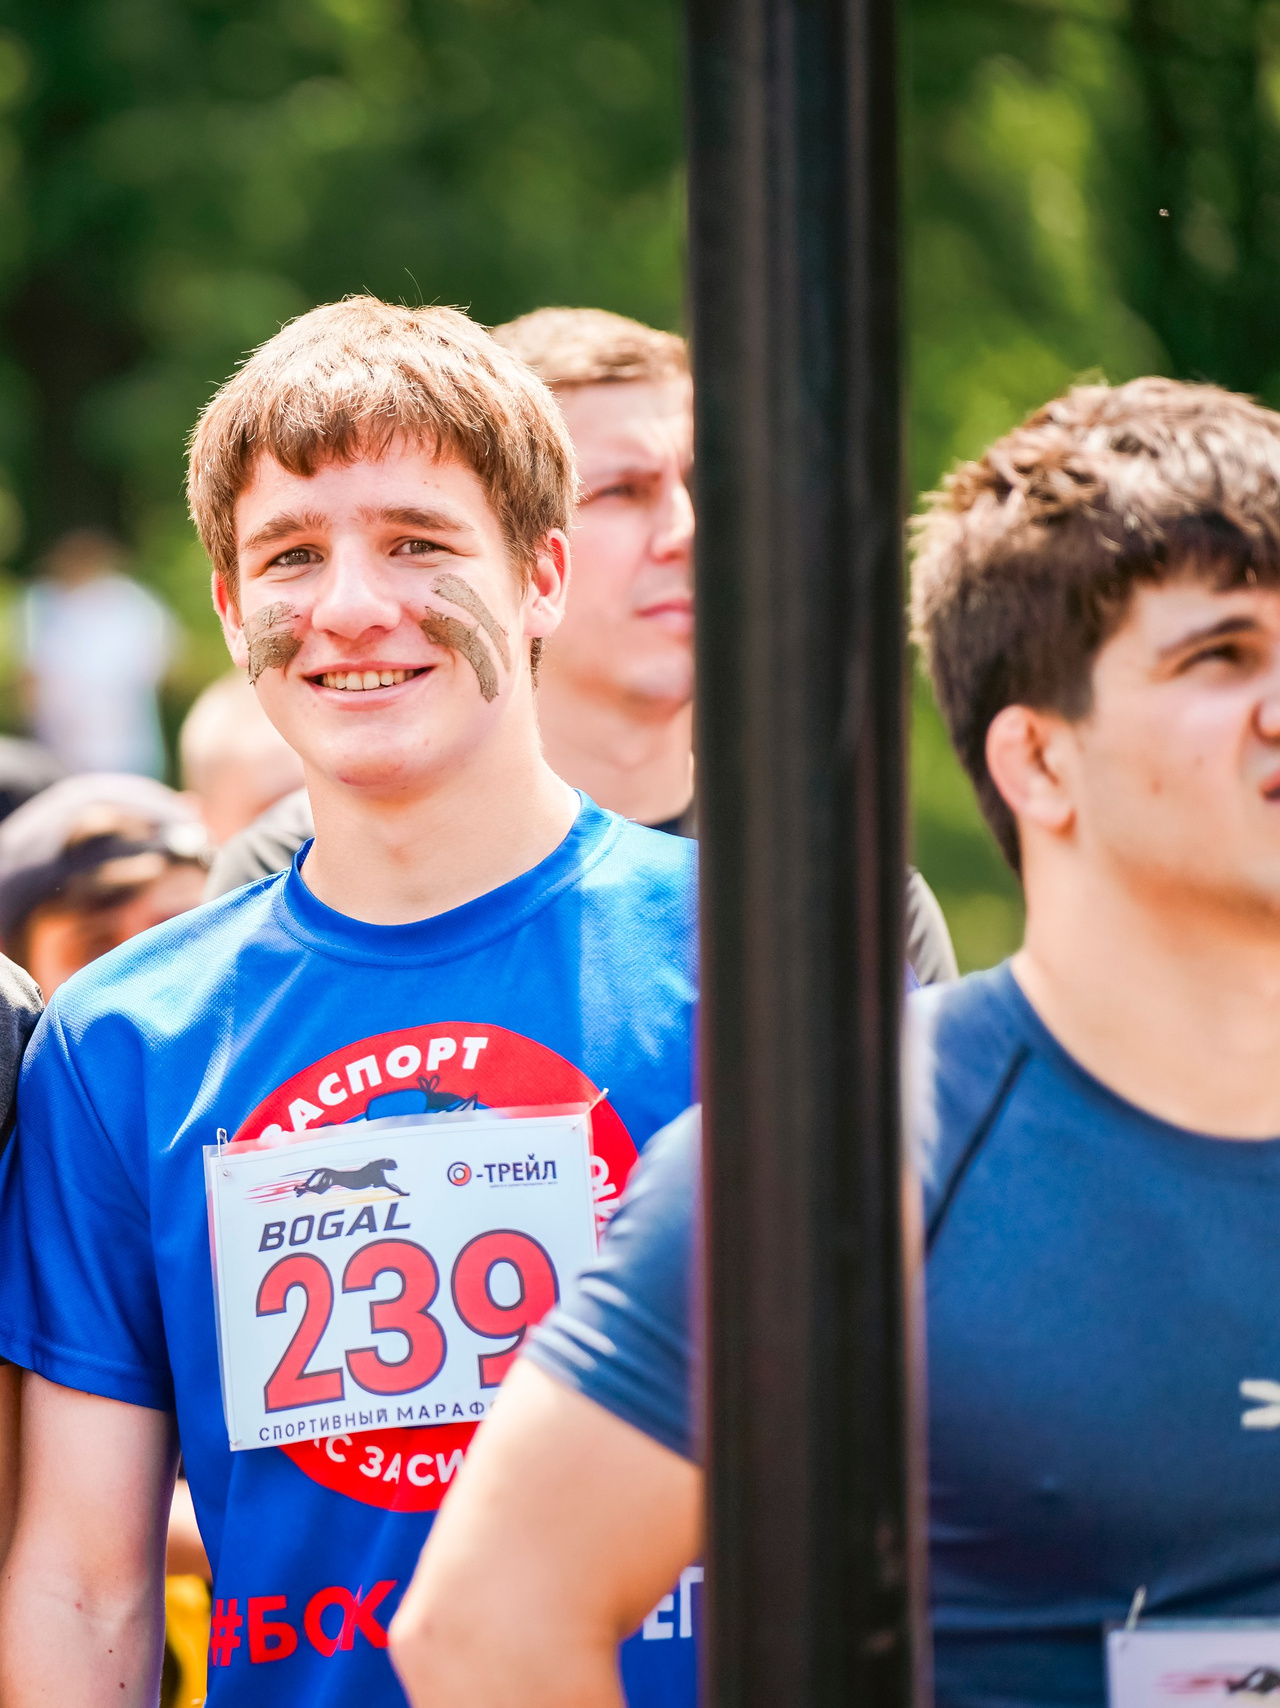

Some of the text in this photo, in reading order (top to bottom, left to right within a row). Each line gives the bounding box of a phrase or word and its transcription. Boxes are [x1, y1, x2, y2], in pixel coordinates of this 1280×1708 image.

[257, 1202, 412, 1253] BOGAL
[255, 1228, 560, 1414] 239
[258, 1400, 496, 1442] СПОРТИВНЫЙ МАРАФ
[210, 1579, 398, 1668] #БОК
